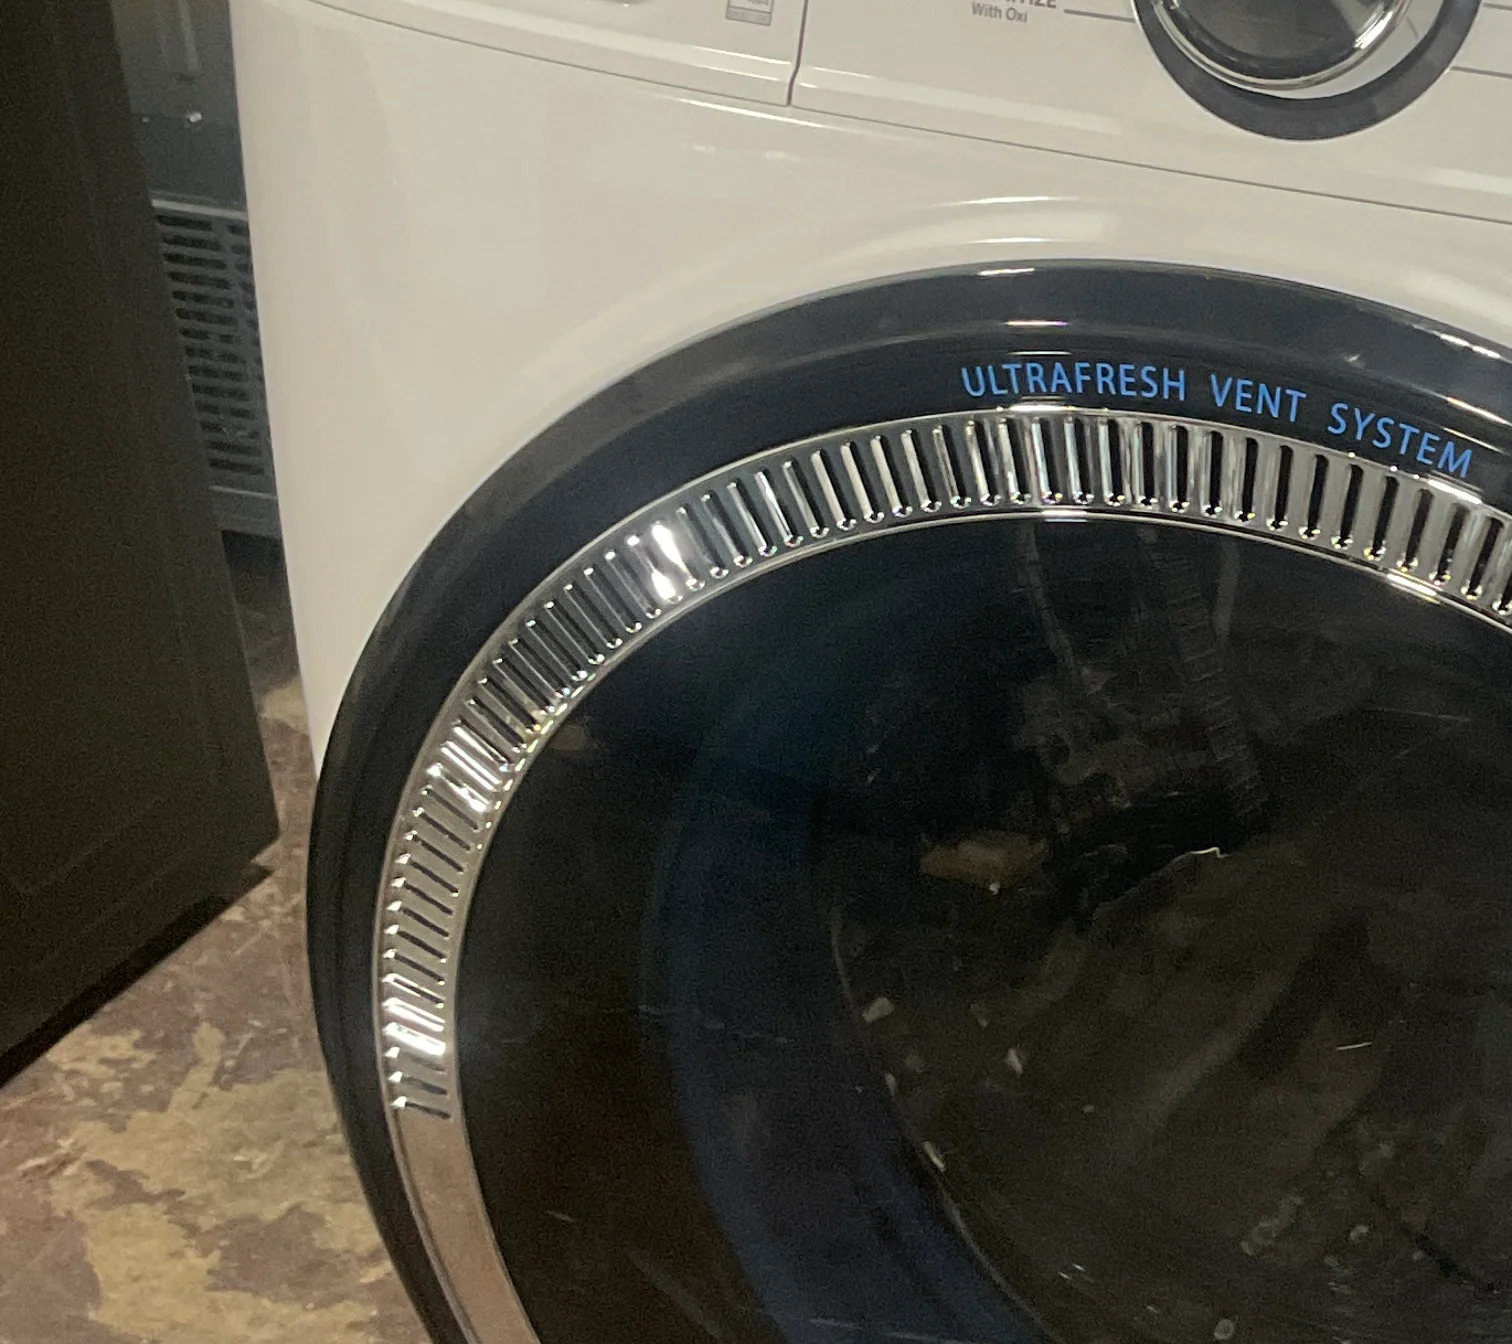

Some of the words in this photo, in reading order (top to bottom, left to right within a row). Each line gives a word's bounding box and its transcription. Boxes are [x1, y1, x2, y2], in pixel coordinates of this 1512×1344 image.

[971, 2, 1003, 20] With
[1006, 7, 1029, 23] Oxi
[960, 361, 1187, 403] ULTRAFRESH
[1209, 372, 1308, 424] VENT
[1327, 401, 1474, 480] SYSTEM
